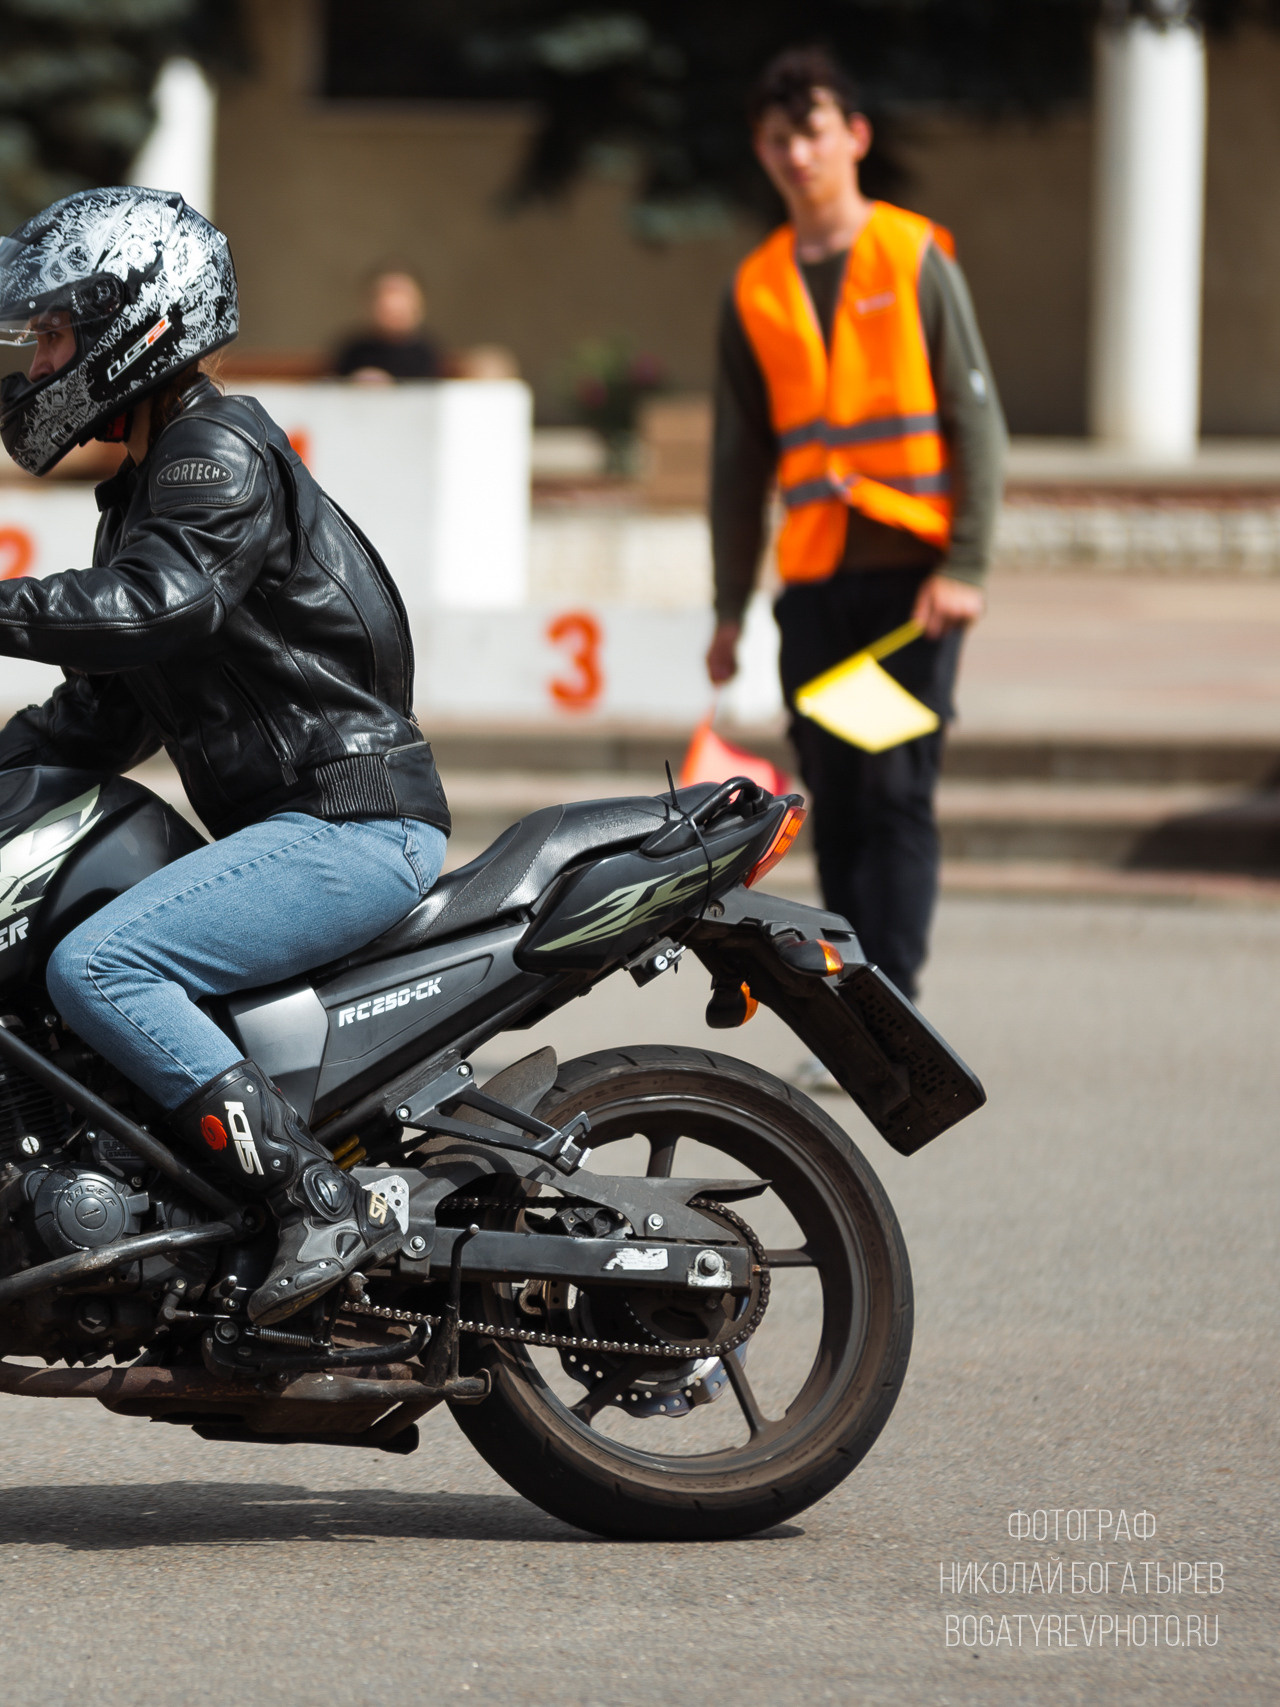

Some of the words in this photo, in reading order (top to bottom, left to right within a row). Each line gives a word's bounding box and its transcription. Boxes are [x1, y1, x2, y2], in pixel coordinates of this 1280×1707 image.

[107, 314, 172, 382] LS2
[166, 462, 221, 481] CORTECH
[548, 612, 602, 712] 3
